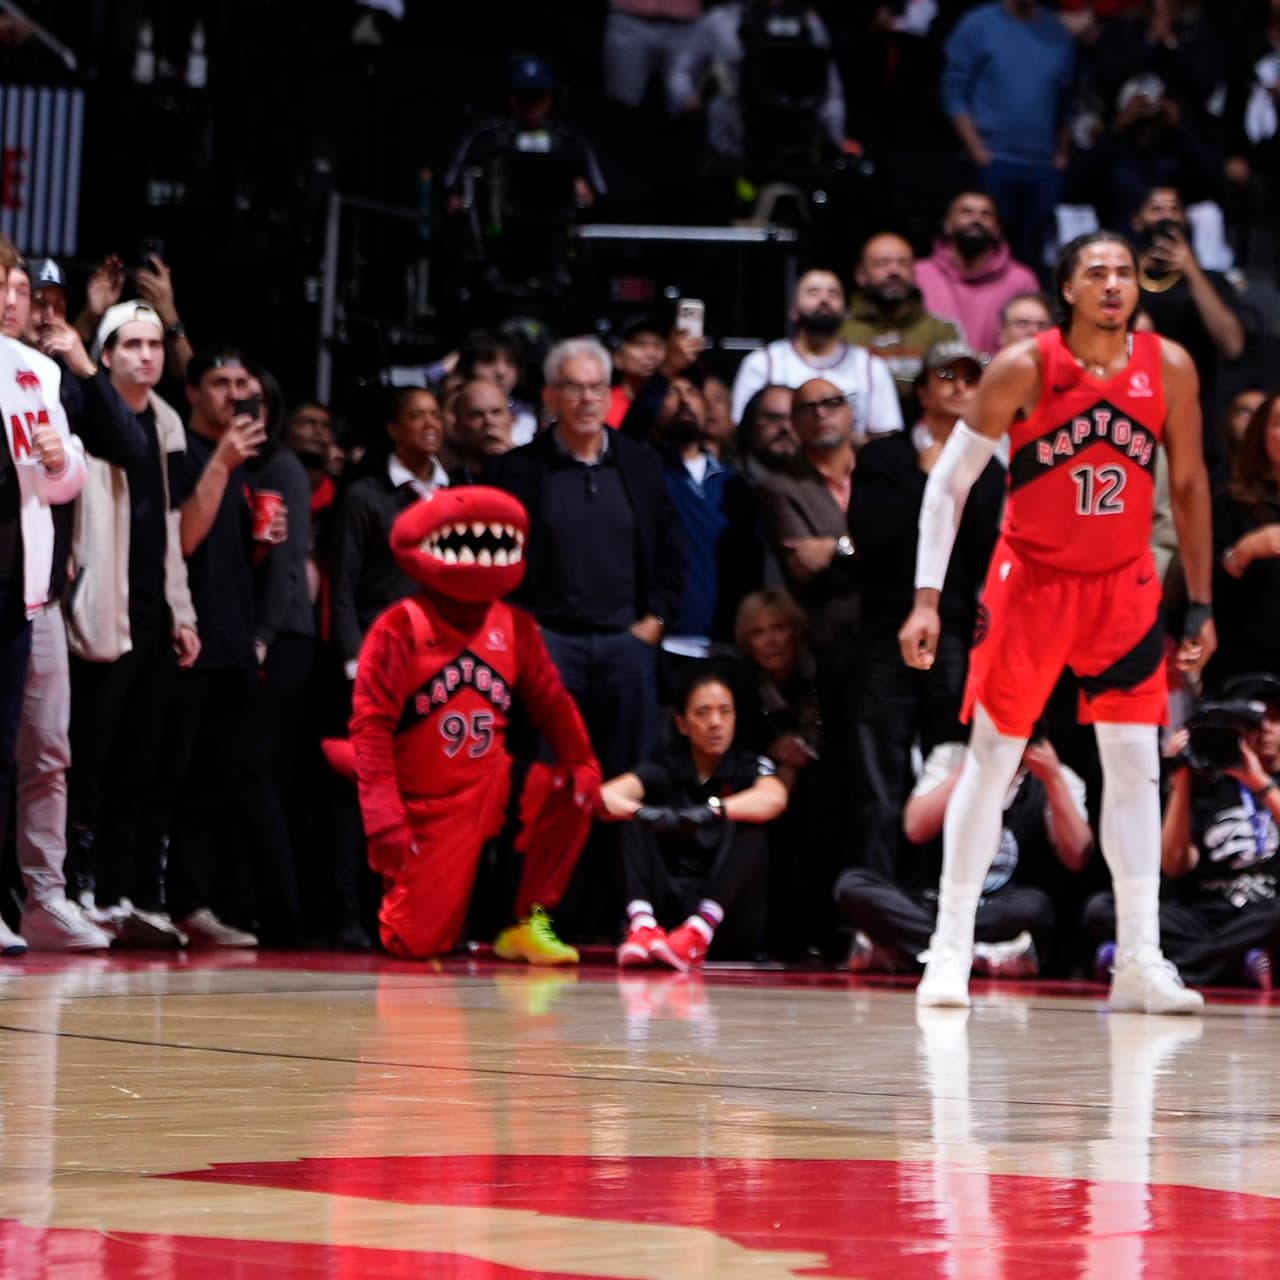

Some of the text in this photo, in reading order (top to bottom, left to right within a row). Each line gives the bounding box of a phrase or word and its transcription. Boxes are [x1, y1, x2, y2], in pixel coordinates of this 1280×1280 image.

[1036, 408, 1153, 466] RAPTORS
[1070, 463, 1127, 516] 12
[438, 709, 495, 759] 95
